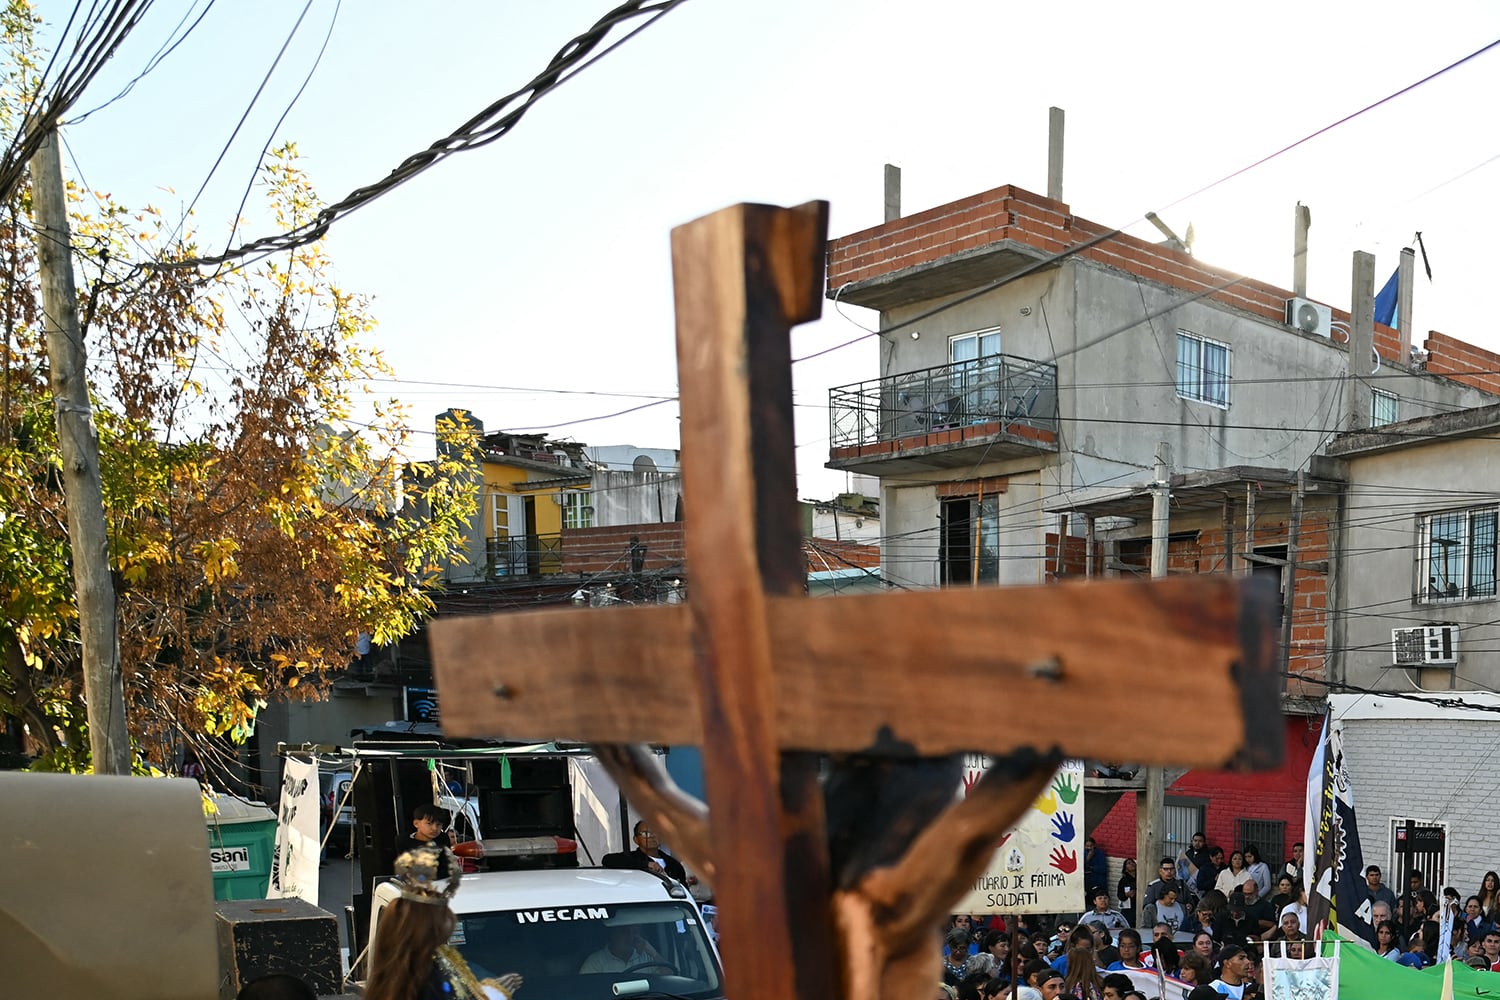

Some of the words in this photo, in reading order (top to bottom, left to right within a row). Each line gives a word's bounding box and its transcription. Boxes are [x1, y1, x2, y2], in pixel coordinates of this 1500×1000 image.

[970, 874, 1009, 891] NTUARIO
[1012, 874, 1025, 889] DE
[986, 892, 1038, 908] SOLDATI
[516, 907, 609, 924] IVECAM
